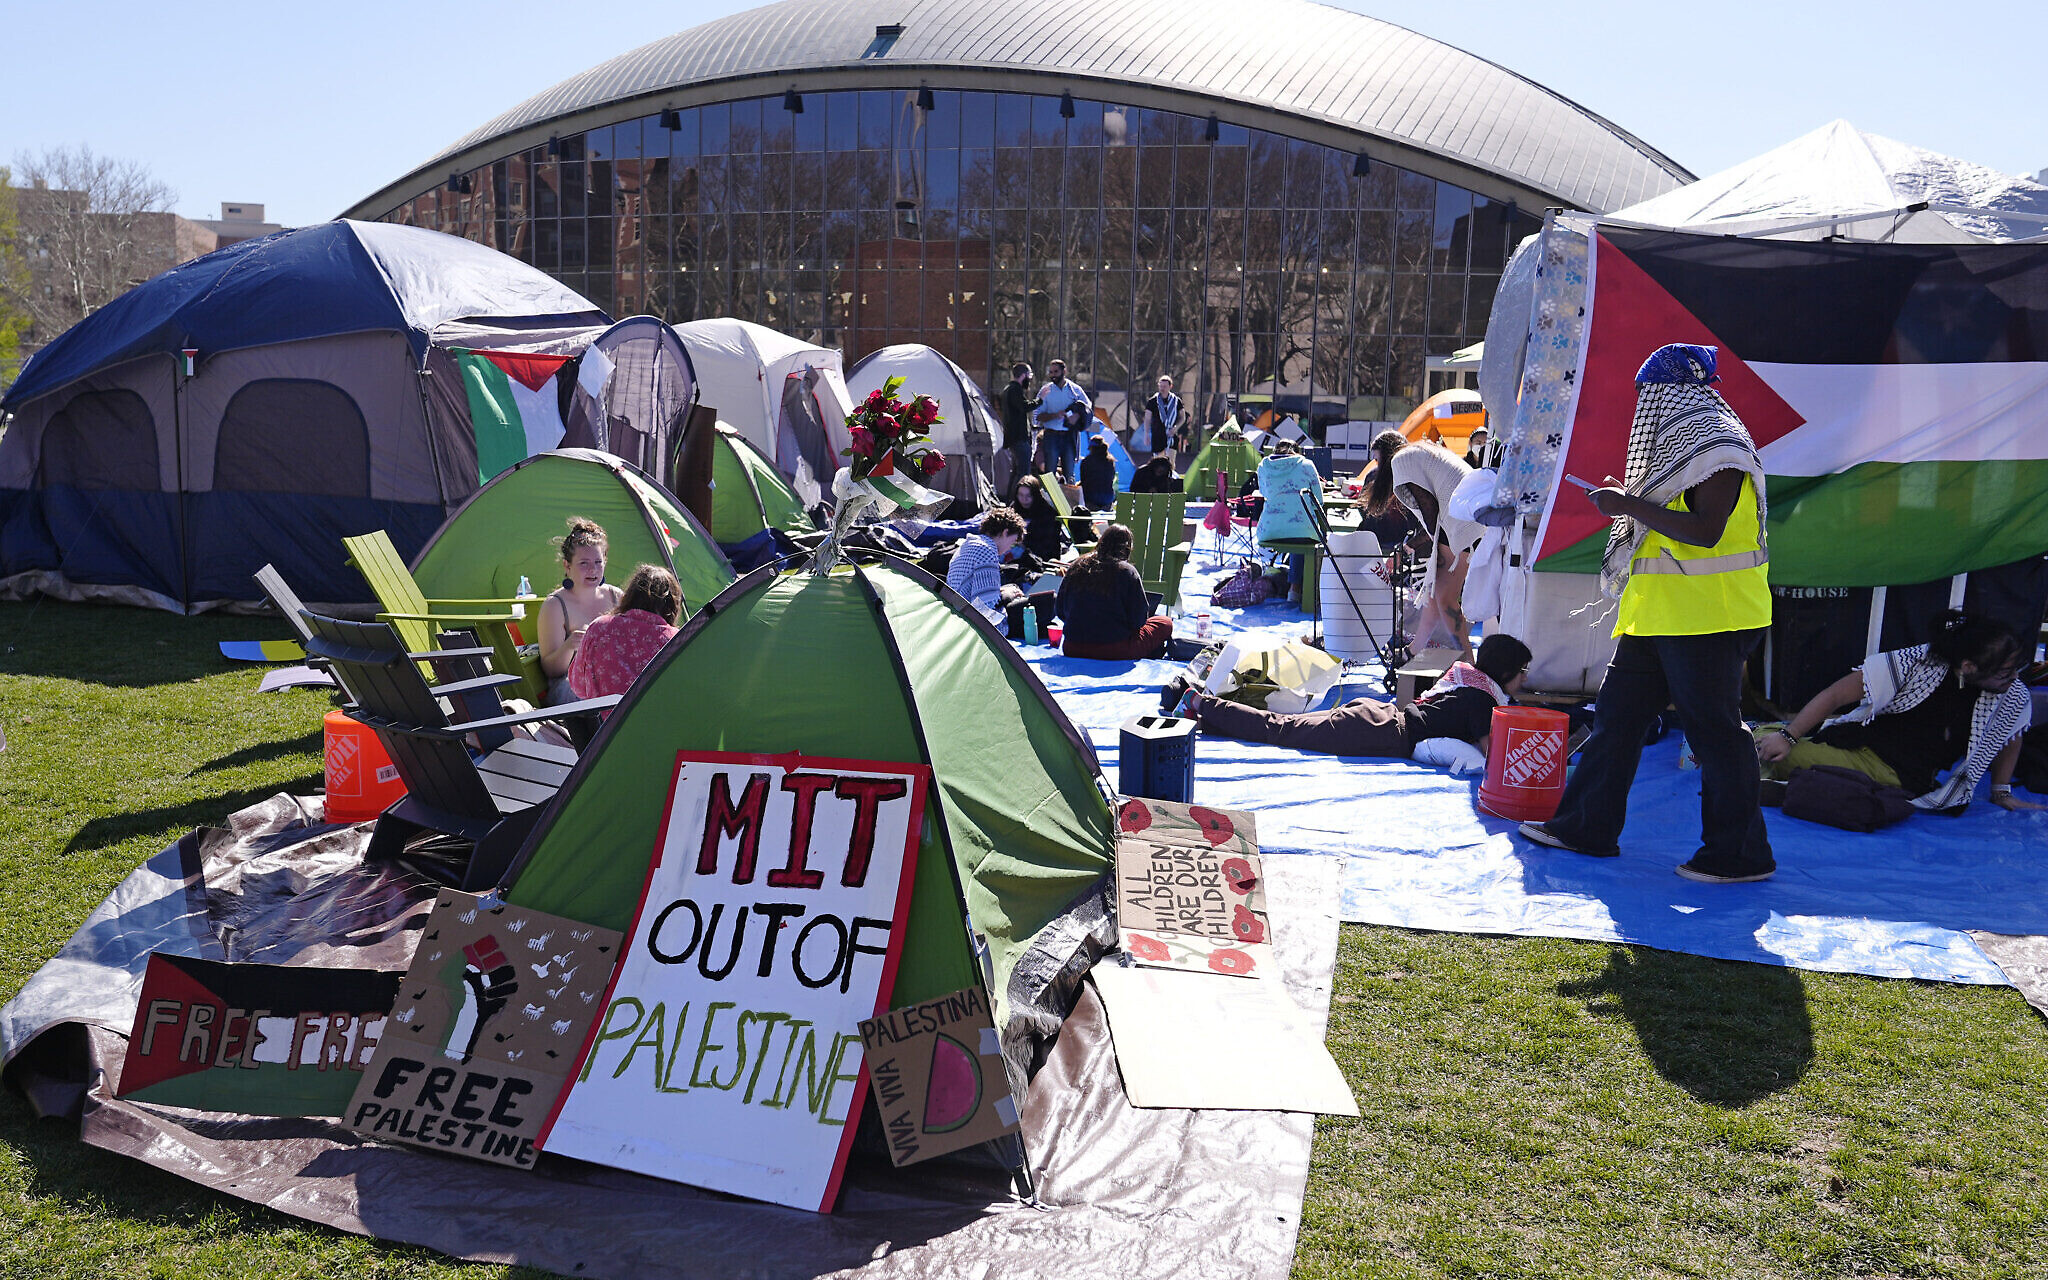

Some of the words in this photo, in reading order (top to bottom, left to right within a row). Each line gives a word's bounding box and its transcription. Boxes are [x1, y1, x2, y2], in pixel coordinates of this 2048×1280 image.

[1504, 732, 1563, 787] HOME
[1506, 731, 1545, 765] DEPOT
[1534, 760, 1558, 783] THE
[695, 773, 907, 889] MIT
[1125, 869, 1152, 910] ALL
[1150, 844, 1179, 940] CHILDREN
[1173, 849, 1199, 887] OUR
[1195, 844, 1234, 946] CHILDREN
[1177, 895, 1204, 935] ARE
[140, 999, 272, 1070] FREE
[861, 988, 983, 1049] PALESTINA
[578, 997, 863, 1126] PALESTINE
[875, 1058, 905, 1107] VIVA
[373, 1057, 533, 1128] FREE
[354, 1102, 536, 1165] PALESTINE
[889, 1110, 919, 1164] VIVA
